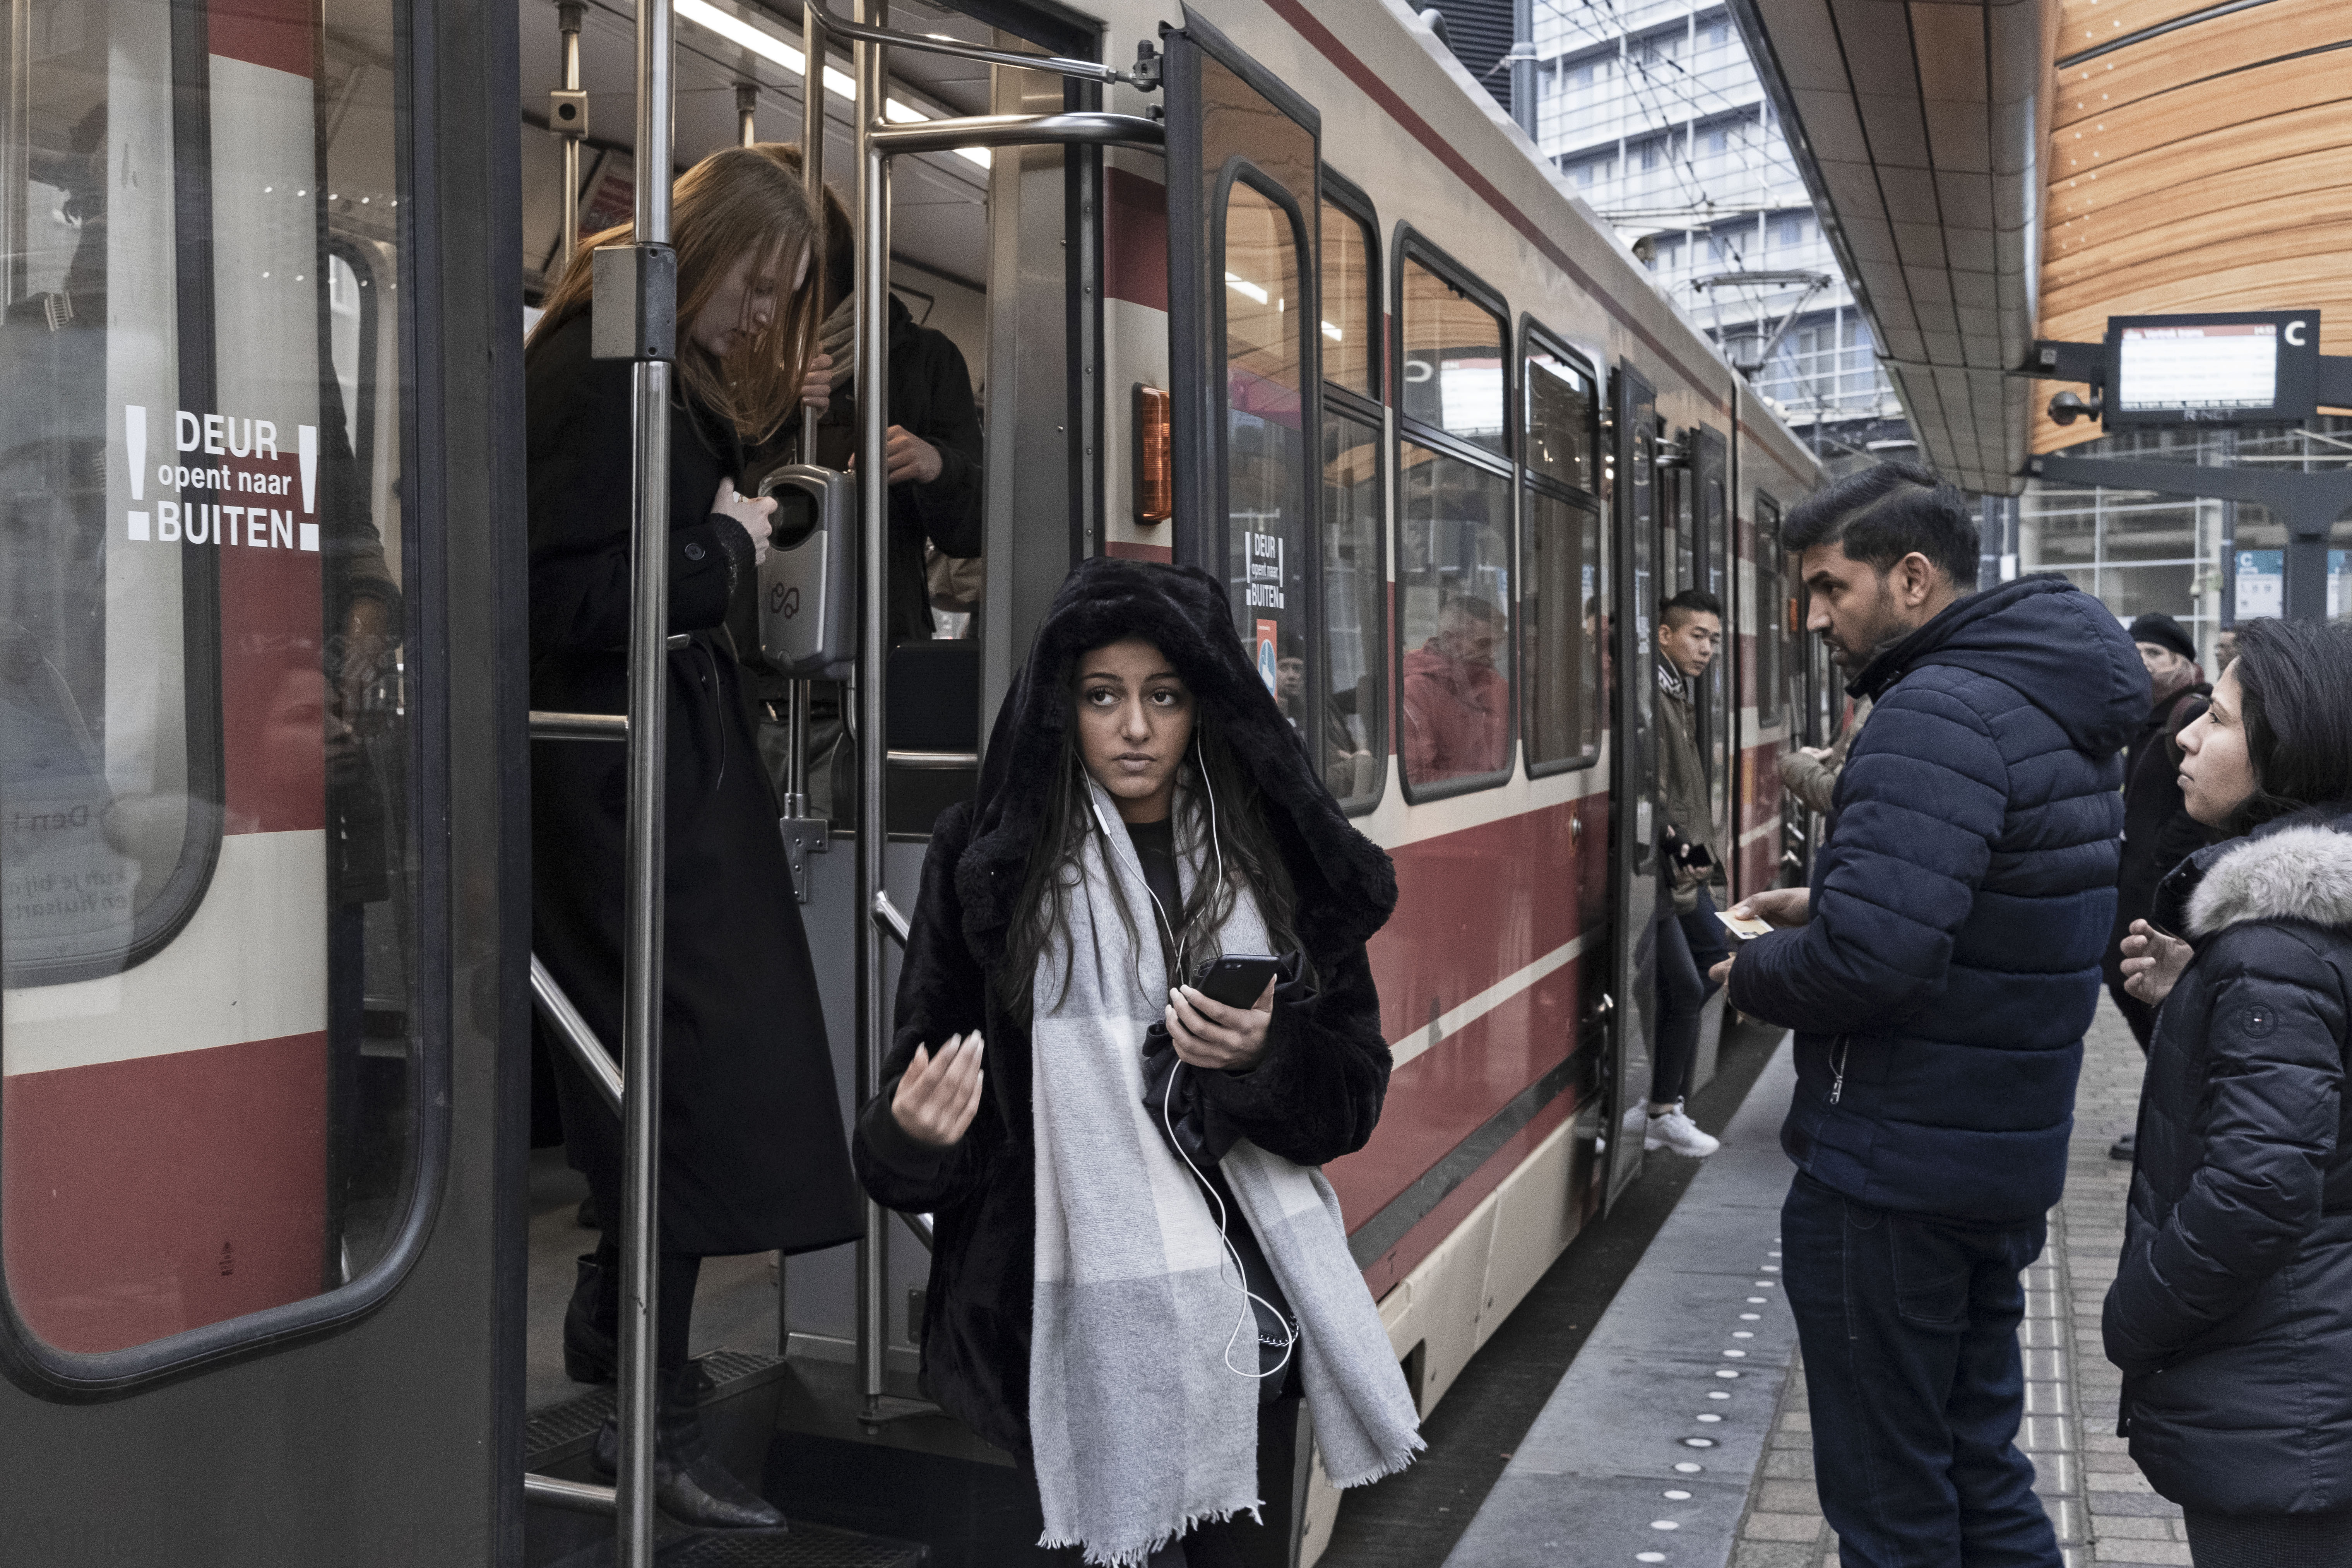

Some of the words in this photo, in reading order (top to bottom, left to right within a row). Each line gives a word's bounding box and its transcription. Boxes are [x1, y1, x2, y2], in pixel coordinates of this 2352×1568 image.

[2285, 320, 2306, 346] C
[176, 410, 278, 460] DEUR
[158, 465, 231, 493] opent
[238, 471, 292, 495] naar
[158, 500, 293, 549] BUITEN
[1254, 533, 1276, 558] DEUR
[1251, 562, 1267, 579] opent
[1267, 566, 1278, 578] naar
[1251, 583, 1279, 608] BUITEN
